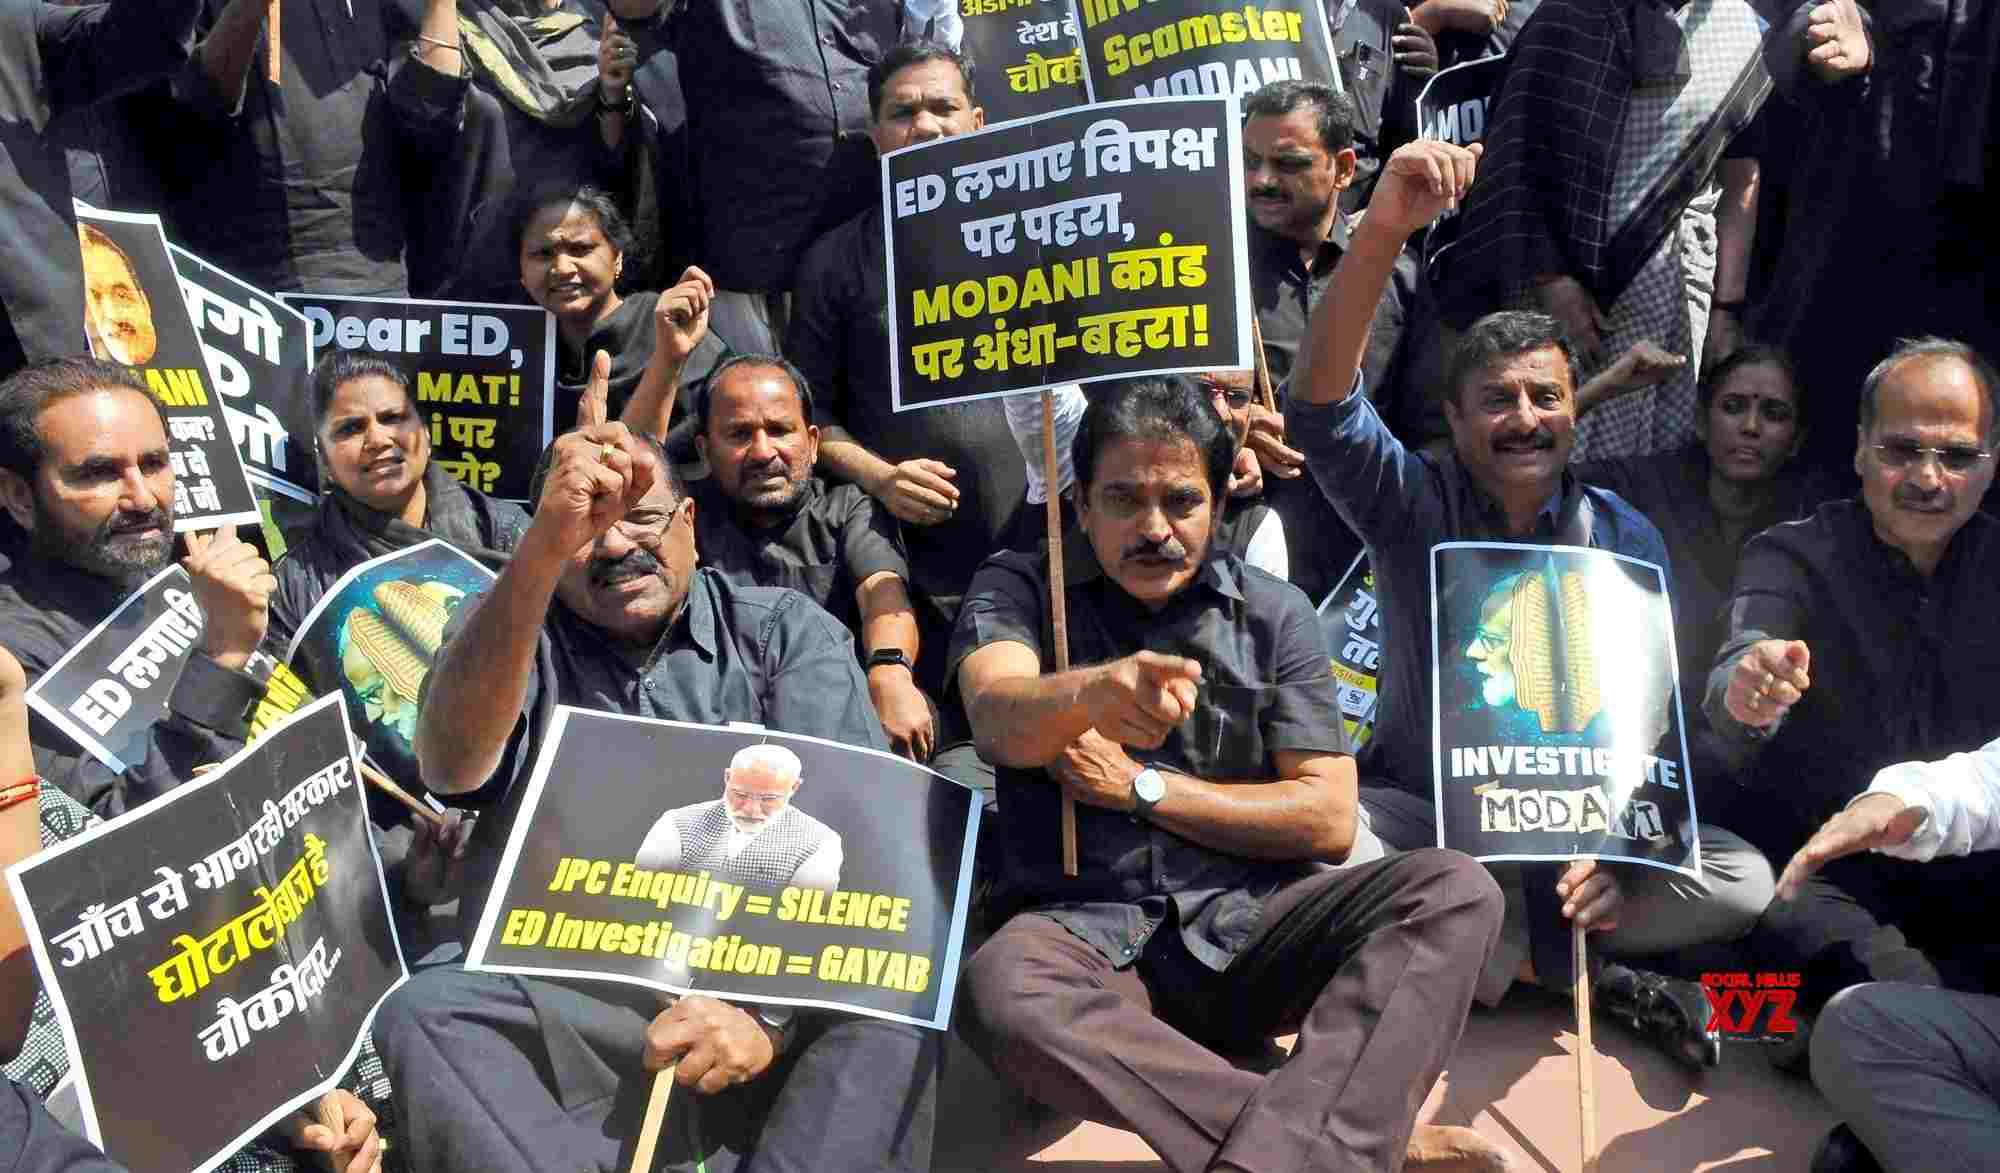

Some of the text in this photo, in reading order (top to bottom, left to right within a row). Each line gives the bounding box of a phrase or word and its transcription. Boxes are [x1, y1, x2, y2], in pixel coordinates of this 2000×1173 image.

[1103, 6, 1302, 76] Scamster
[896, 119, 1217, 218] ED लगाए विपक्ष
[961, 192, 1135, 257] पर पहरा,
[912, 233, 1208, 327] MODANI कांड
[304, 306, 524, 369] Dear ED,
[911, 304, 1209, 382] पर अंधा-बहरा!
[417, 371, 521, 406] MAT!
[448, 416, 496, 449] पर
[67, 678, 133, 737] ED
[1451, 745, 1680, 790] INVESTIGTE
[50, 756, 352, 967] जाँच से भाग रही सरकार
[548, 857, 911, 932] JPC Enquiry = SILENCE
[501, 909, 930, 993] ED Investigation = GAYAB
